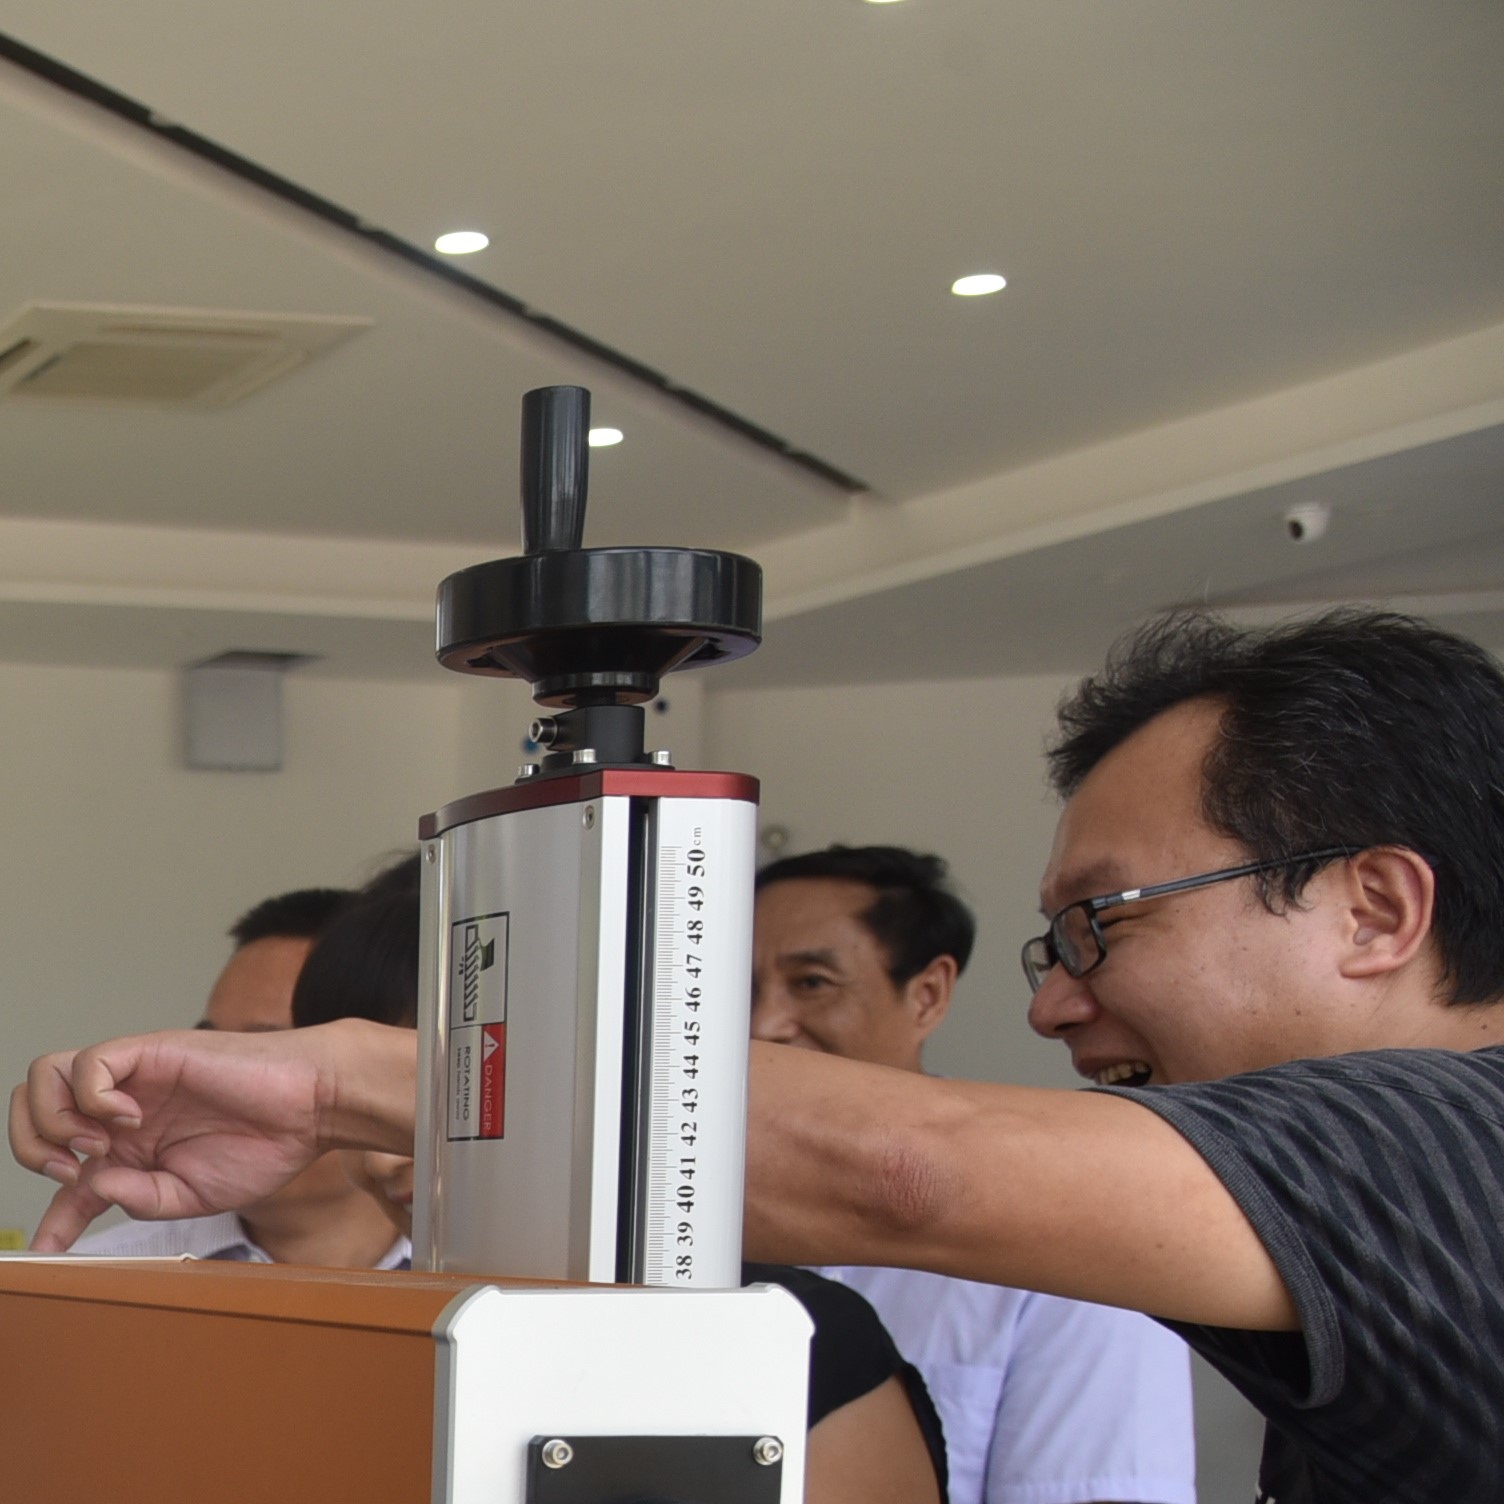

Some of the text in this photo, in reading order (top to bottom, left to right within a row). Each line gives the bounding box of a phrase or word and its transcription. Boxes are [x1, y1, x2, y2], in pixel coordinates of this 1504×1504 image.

[483, 1064, 494, 1131] DANGER
[676, 826, 705, 1279] 38 39 40 41 42 43 44 45 46 47 48 49 50 cm
